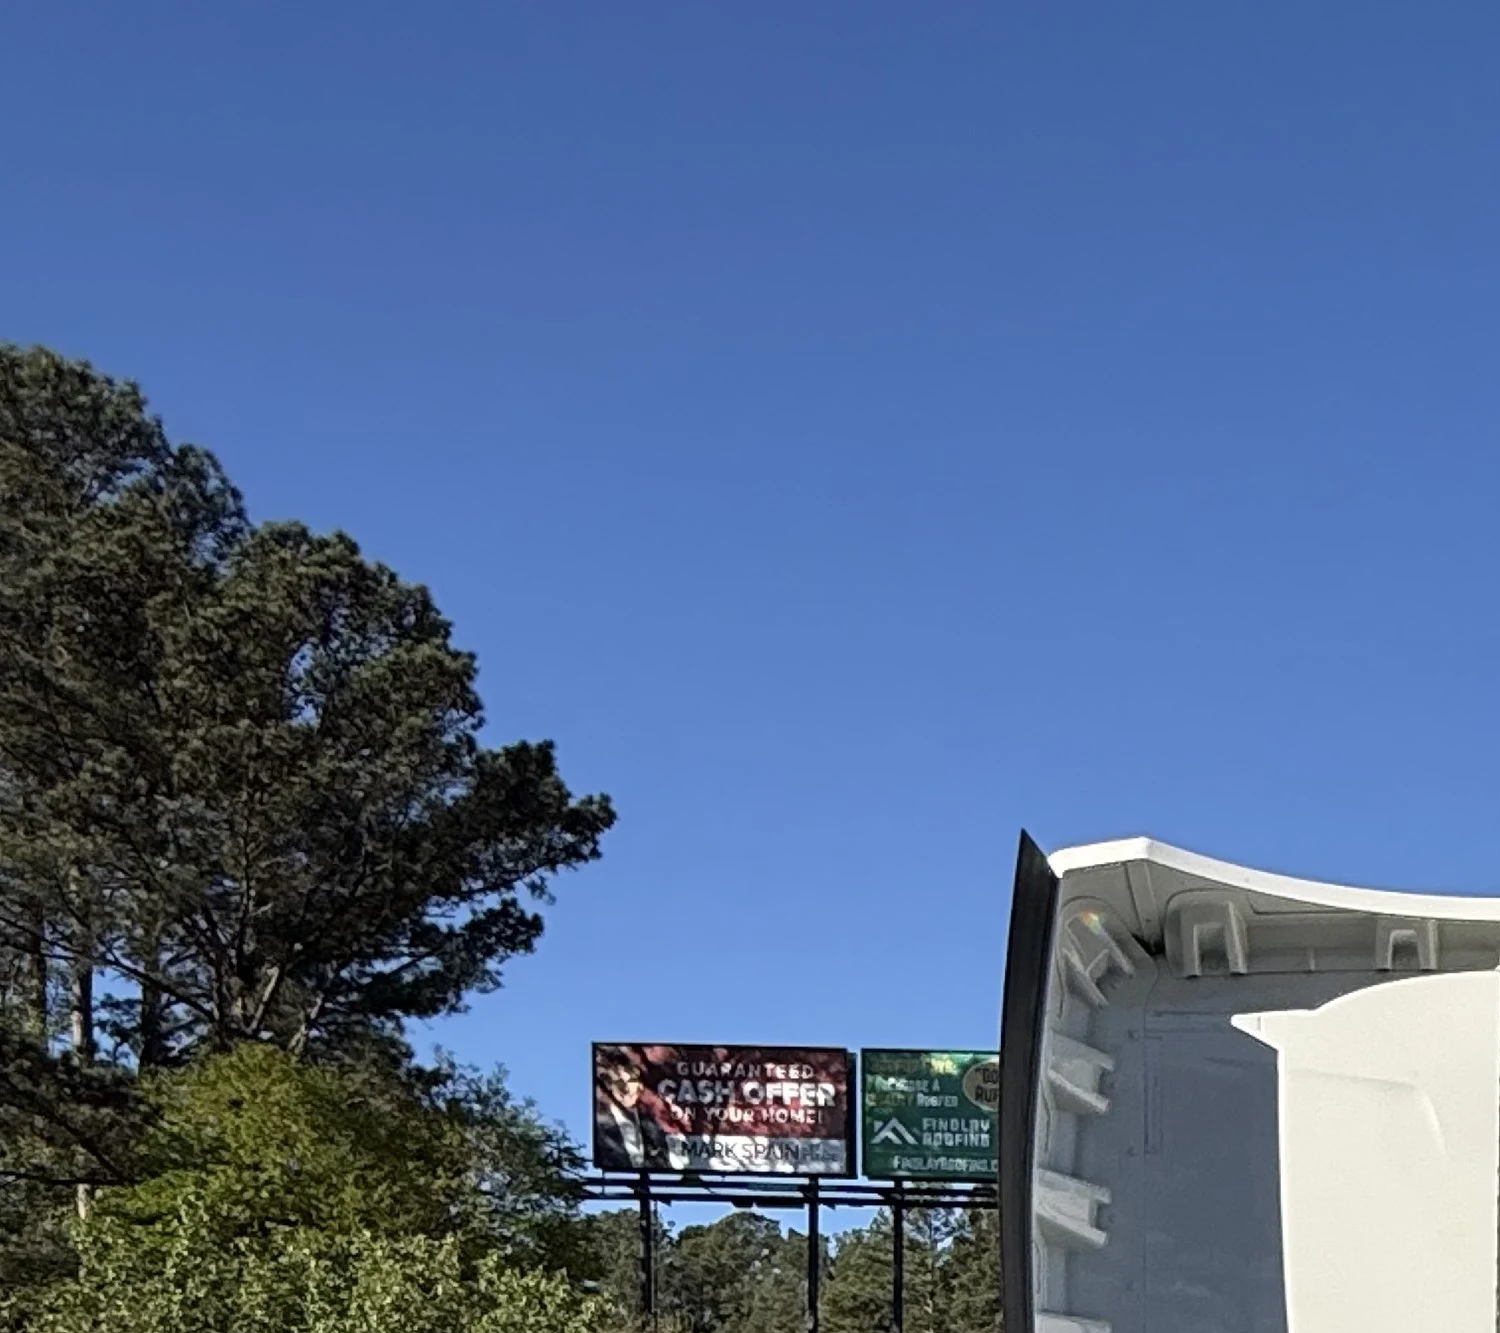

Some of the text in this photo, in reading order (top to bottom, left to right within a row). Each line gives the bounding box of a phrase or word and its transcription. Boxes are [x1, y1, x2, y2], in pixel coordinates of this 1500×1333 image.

[677, 1061, 816, 1079] GUARANTEED
[657, 1079, 735, 1104] CASH
[742, 1081, 837, 1107] OFFER
[671, 1106, 697, 1121] ON
[705, 1107, 755, 1123] YOUR
[922, 1117, 990, 1133] FINDLAY
[922, 1132, 990, 1148] ROOFING
[682, 1141, 735, 1159] MARK
